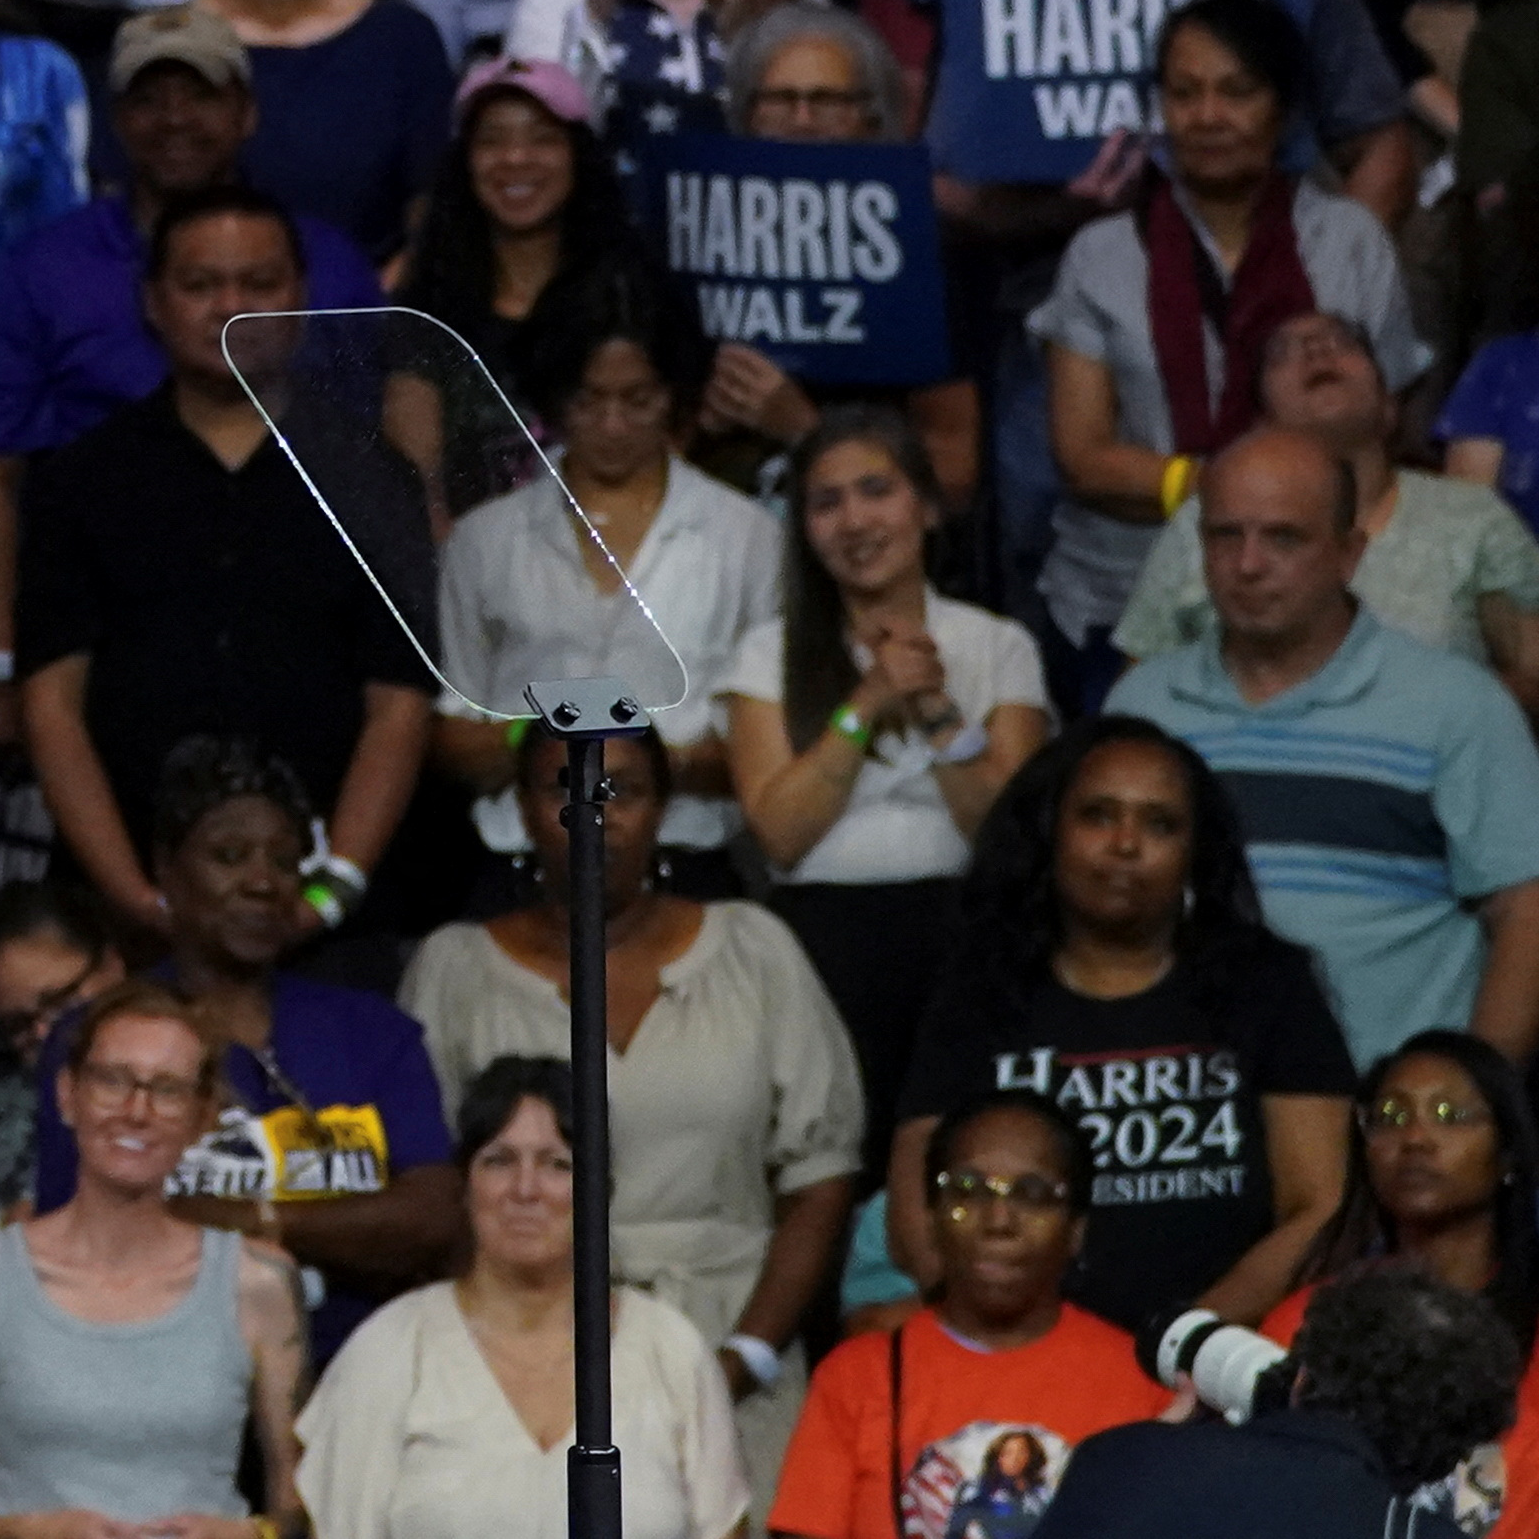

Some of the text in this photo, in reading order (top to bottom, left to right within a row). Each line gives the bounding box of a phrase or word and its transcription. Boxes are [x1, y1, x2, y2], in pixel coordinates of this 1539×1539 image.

[667, 172, 903, 284] HARRIS
[699, 286, 867, 344] WALZ
[1078, 1100, 1244, 1167] 2024
[1090, 1164, 1245, 1206] ESIDENT
